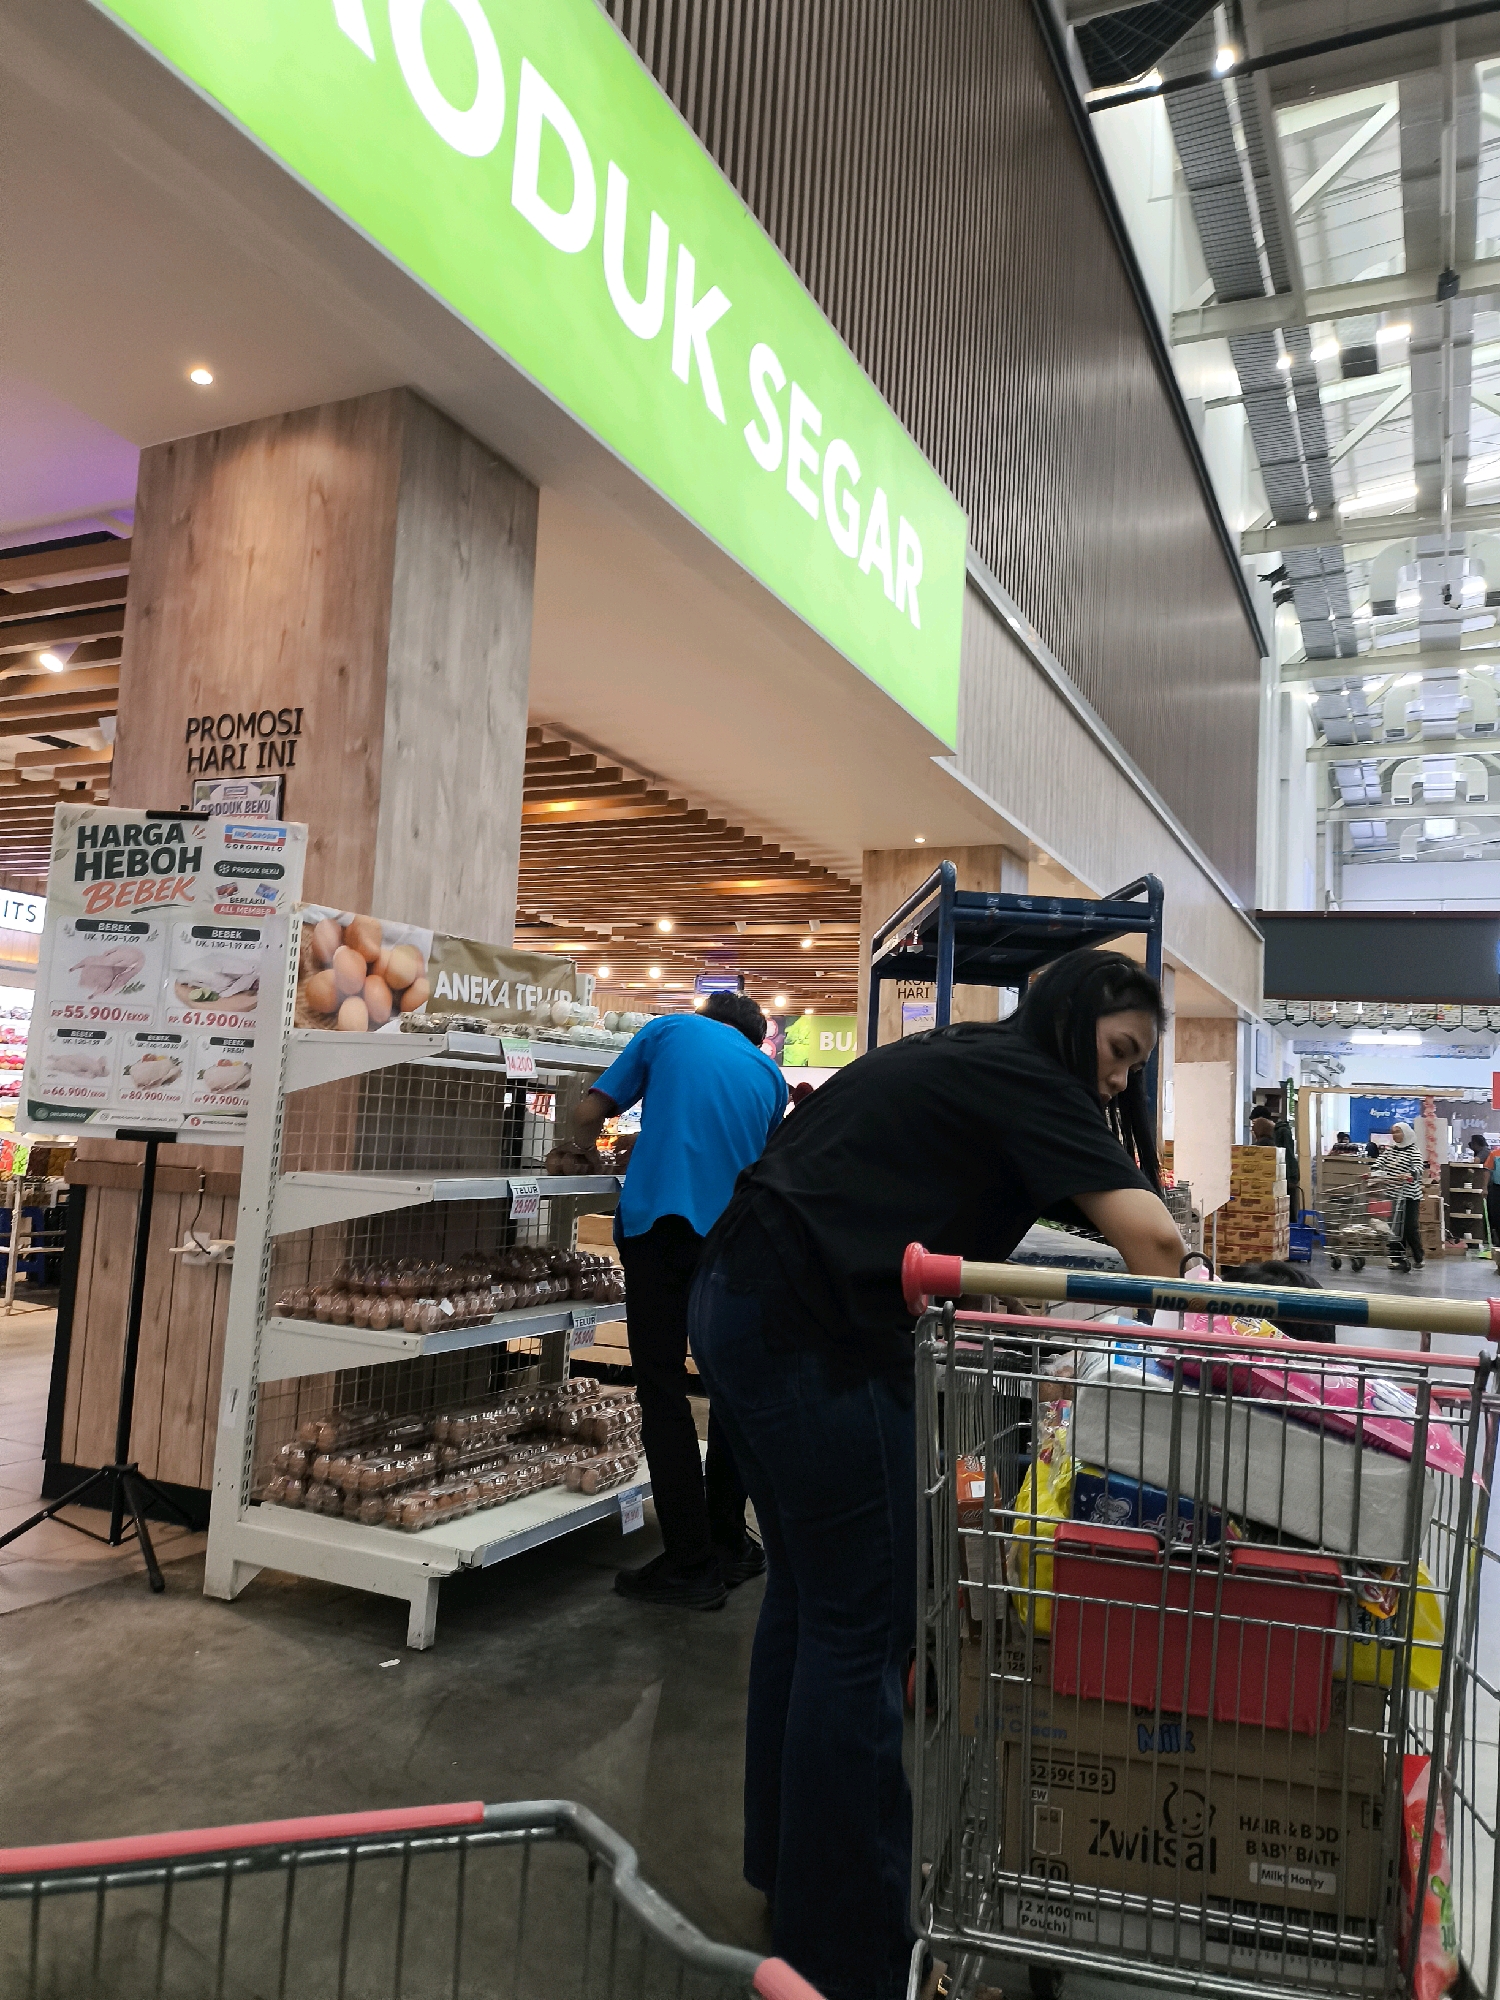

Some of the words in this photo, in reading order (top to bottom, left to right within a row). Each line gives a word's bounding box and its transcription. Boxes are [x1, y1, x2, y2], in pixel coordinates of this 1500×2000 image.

[332, 0, 732, 426] ODUK
[743, 342, 924, 630] SEGAR
[185, 708, 304, 743] PROMOSI
[187, 743, 248, 774] HARI
[256, 739, 297, 769] INI
[200, 801, 244, 816] PRODUK
[244, 799, 271, 814] BEKU
[77, 823, 186, 849] HARGA
[74, 846, 203, 882] HEBOH
[82, 876, 196, 915] BEBEK
[229, 897, 266, 905] BERLAKU
[218, 905, 234, 913] ALL
[234, 906, 275, 916] MEMBER
[98, 922, 132, 932] BEBEK
[211, 929, 242, 939] BEBEK
[434, 970, 511, 1009] ANEKA
[897, 986, 930, 999] HARI
[1137, 1722, 1196, 1754] Milk
[1031, 1789, 1048, 1801] EW
[1239, 1816, 1281, 1836] HAIR
[1283, 1821, 1298, 1838] &
[1088, 1817, 1217, 1875] Zwitsal
[1245, 1840, 1293, 1860] BABY
[1296, 1846, 1341, 1867] BATH
[1290, 1873, 1325, 1890] Hony
[1047, 1904, 1071, 1919] 400
[1074, 1910, 1095, 1923] mL
[1021, 1914, 1068, 1936] Pouch)
